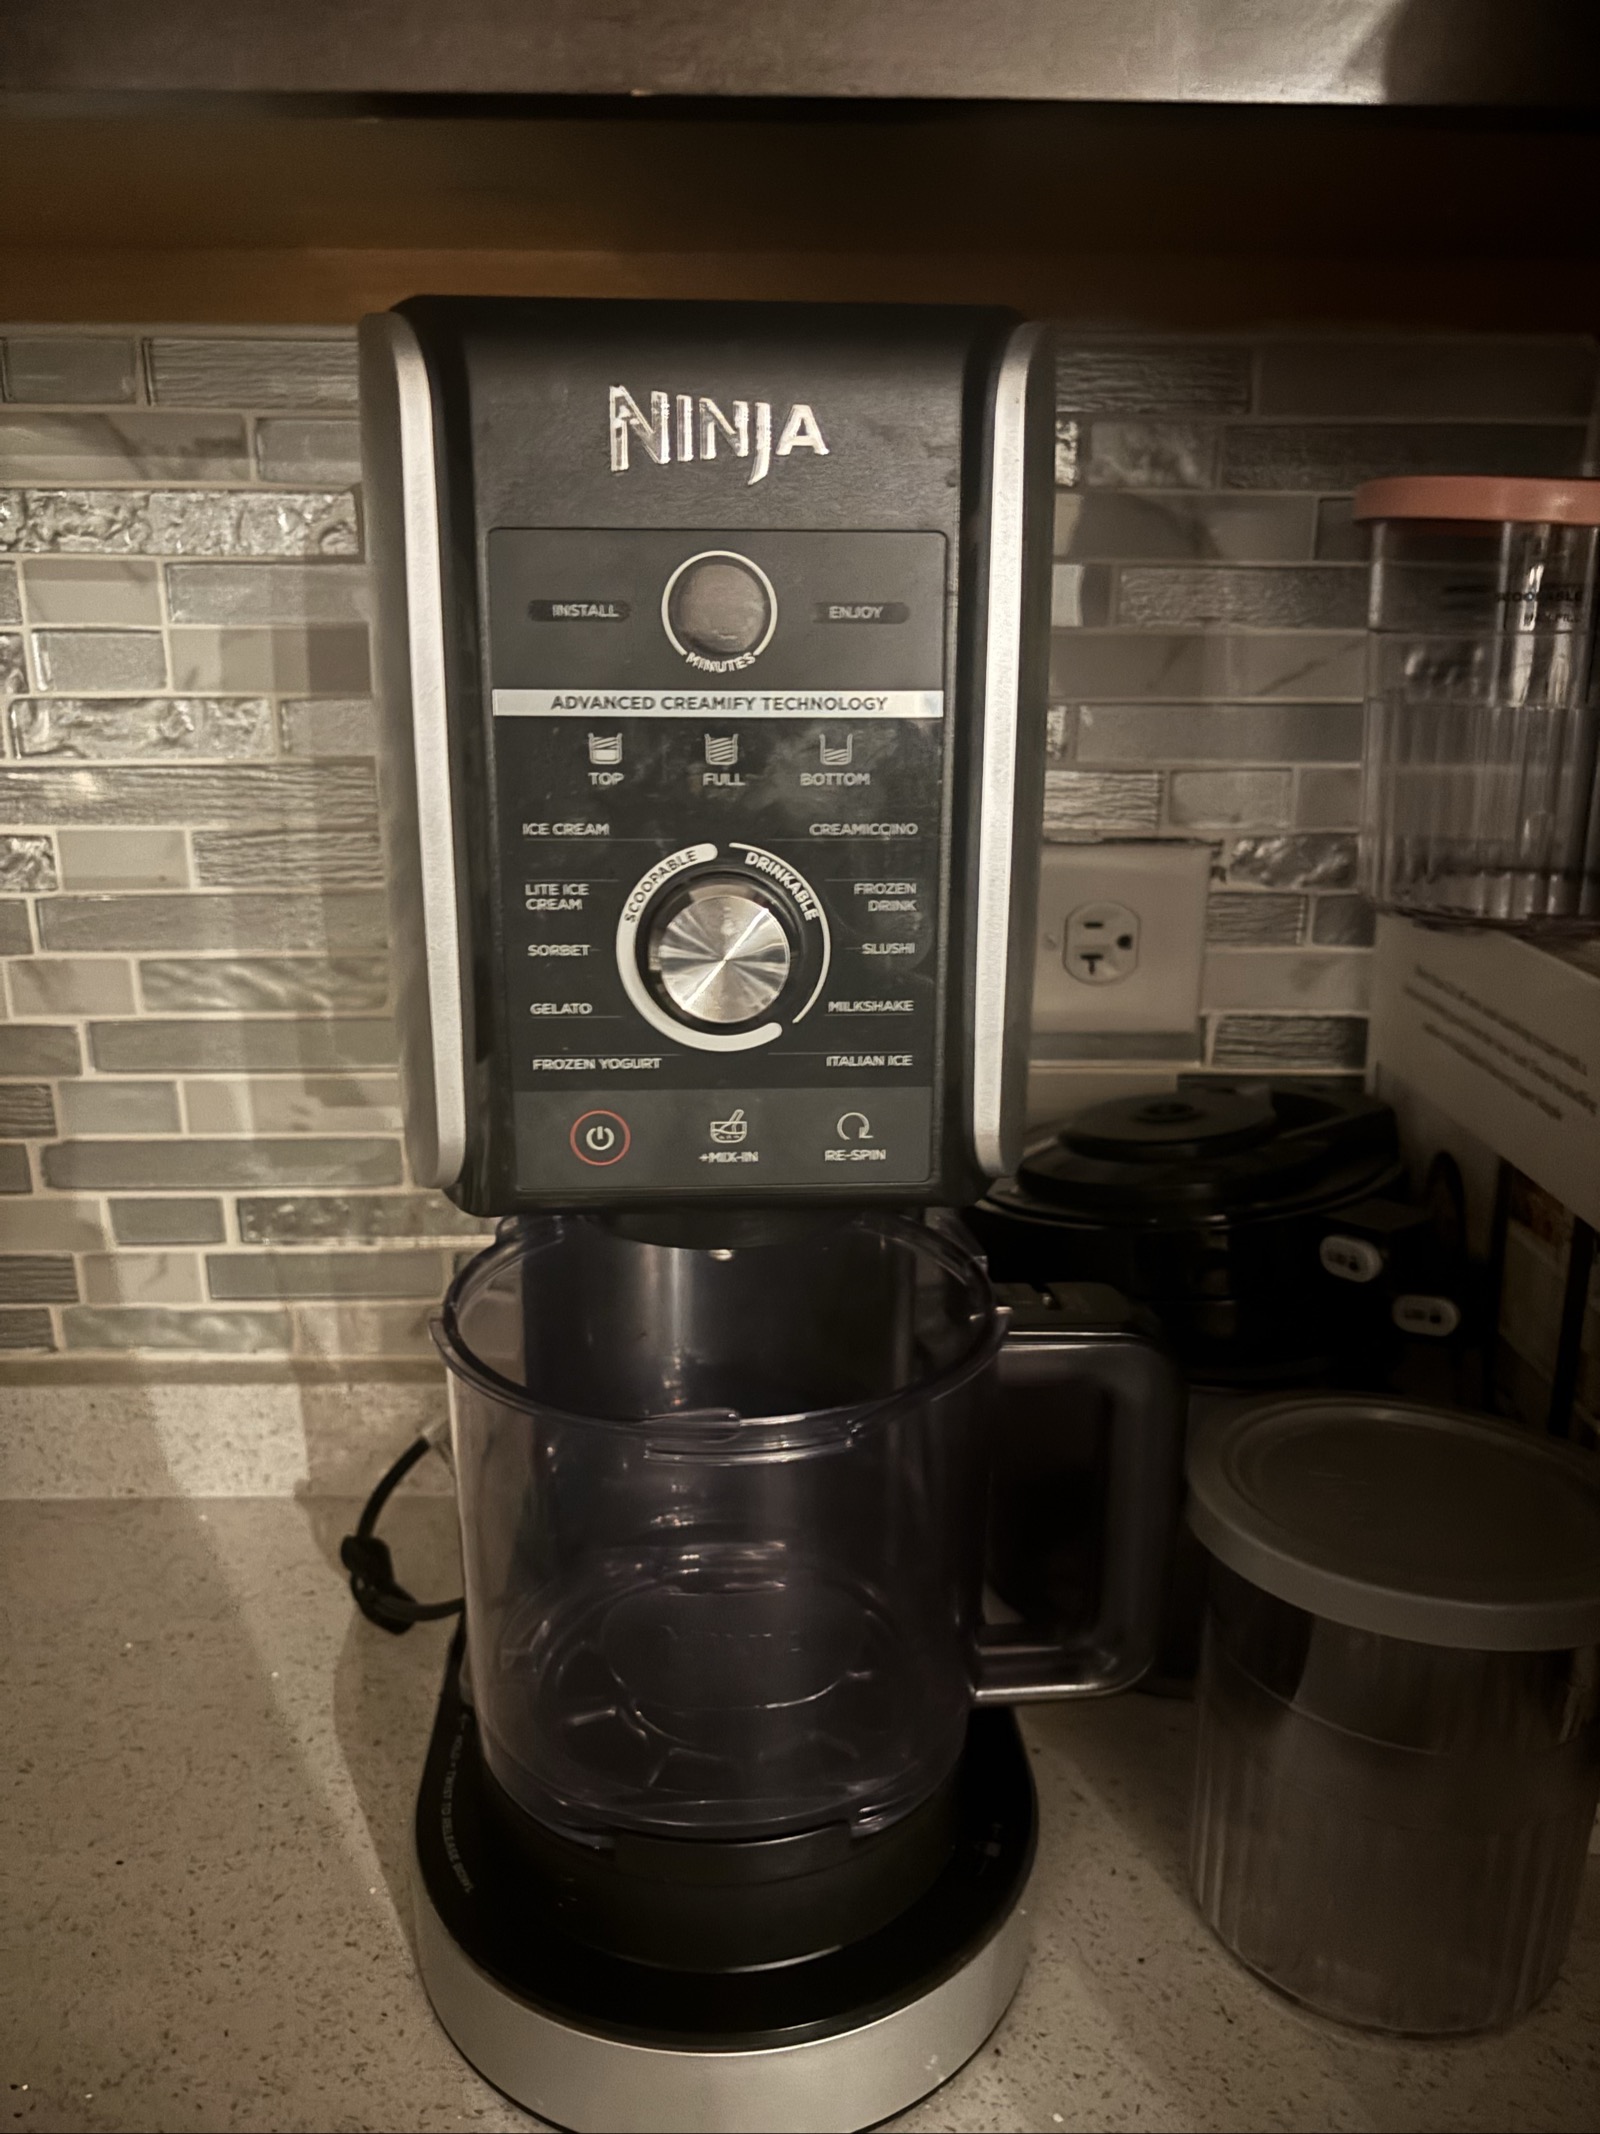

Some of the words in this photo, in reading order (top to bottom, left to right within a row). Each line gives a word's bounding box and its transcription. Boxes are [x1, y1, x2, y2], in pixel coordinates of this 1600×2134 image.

[609, 385, 830, 485] NINJA
[552, 603, 619, 618] INSTALL
[829, 605, 883, 620] ENJOY
[686, 651, 756, 674] MINUTES
[550, 695, 656, 711] ADVANCED
[661, 695, 755, 712] CREAMIFY
[761, 696, 888, 712] TECHNOLOGY
[588, 772, 624, 786] TOP
[702, 772, 745, 787] FULL
[801, 772, 870, 787] BOTTOM
[522, 823, 549, 836] ICE
[553, 823, 609, 836] CREAM
[809, 823, 918, 836] CREAMICCINO
[525, 884, 559, 896] LITE
[563, 884, 589, 896] ICE
[625, 849, 697, 923] SCOOPABLE
[745, 852, 819, 922] DRINKABLE
[854, 883, 917, 895] FROZEN
[526, 898, 583, 911] CREAM
[868, 900, 917, 912] DRINK
[528, 944, 591, 957] SORBET
[862, 943, 916, 956] SLUSHI
[530, 1002, 593, 1016] GELATO
[828, 1000, 915, 1014] MILKSHAKE
[532, 1058, 596, 1071] FROZEN
[599, 1057, 663, 1071] YOGURT
[826, 1055, 885, 1068] ITALIAN
[888, 1055, 913, 1067] ICE
[699, 1151, 759, 1164] +MIX-IN
[824, 1149, 887, 1162] RE-SPIN
